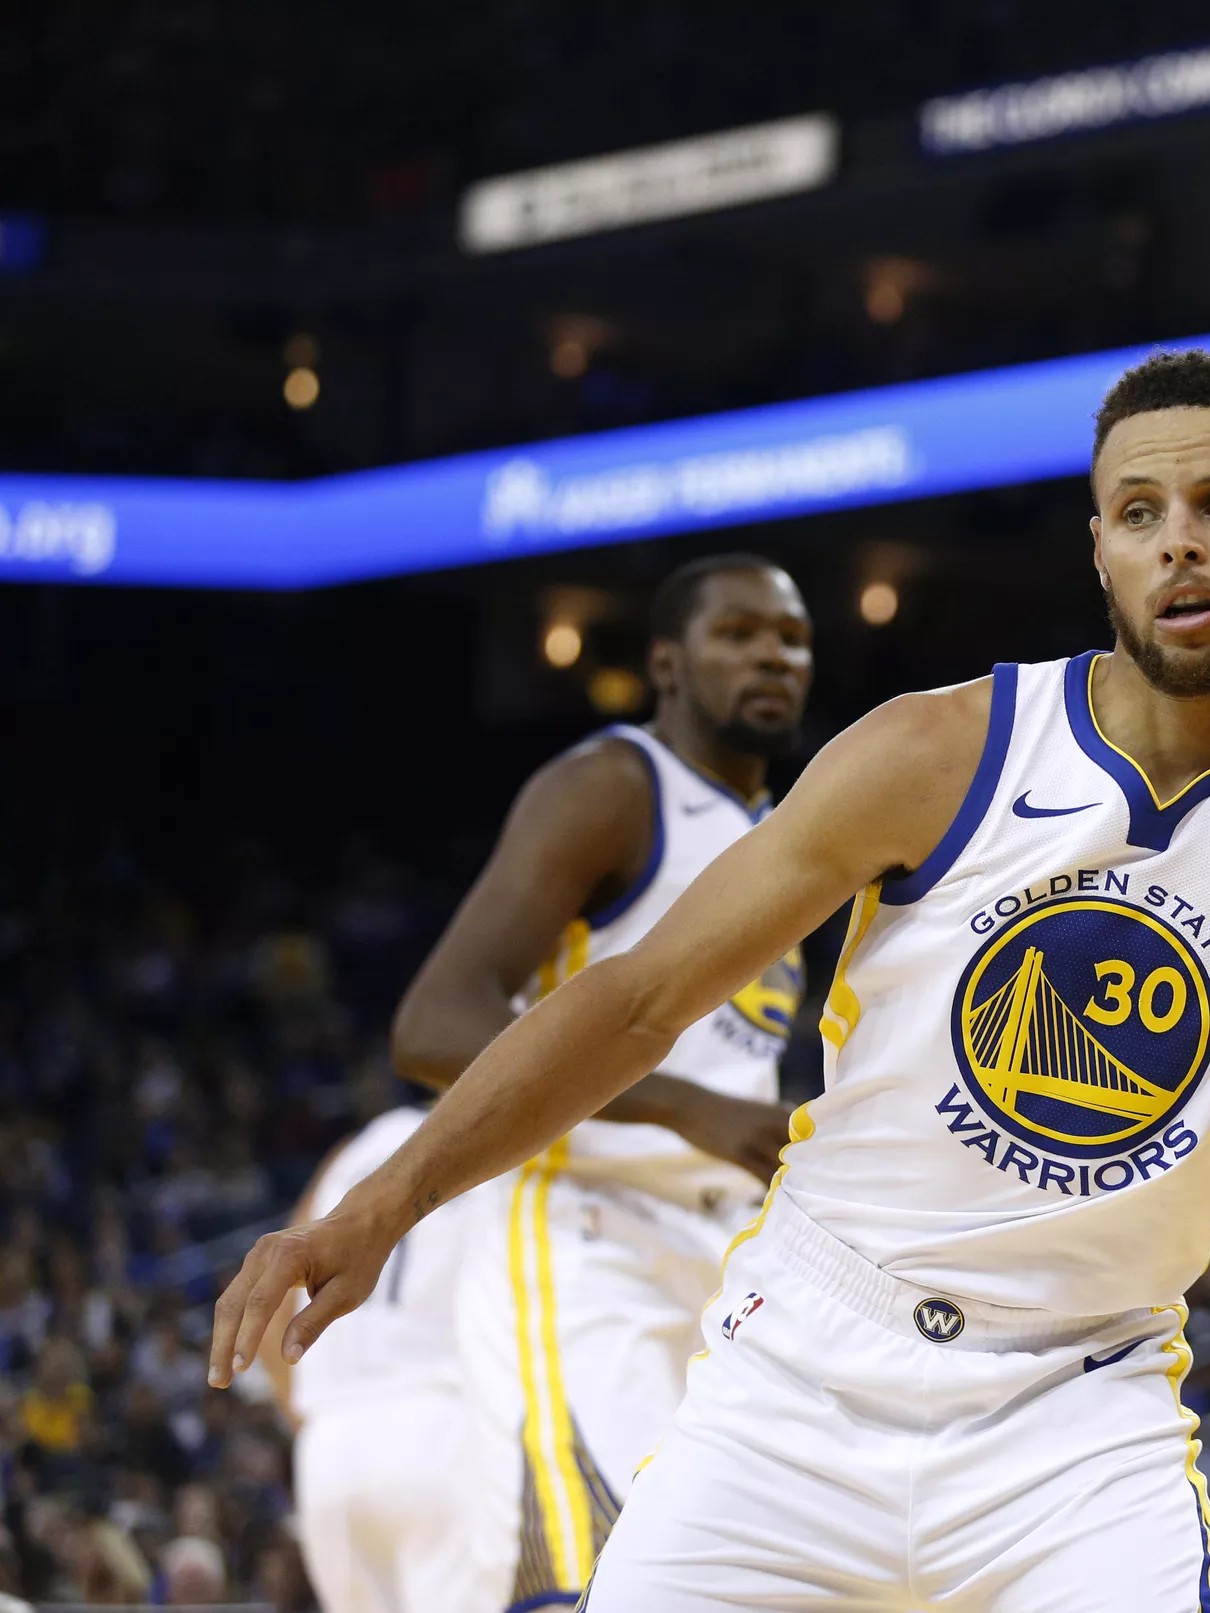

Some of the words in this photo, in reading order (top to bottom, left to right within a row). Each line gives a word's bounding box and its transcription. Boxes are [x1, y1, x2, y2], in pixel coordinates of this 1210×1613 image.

[969, 869, 1131, 935] GOLDEN
[1083, 959, 1187, 1033] 30
[934, 1082, 1200, 1197] WARRIORS
[920, 1305, 961, 1337] W
